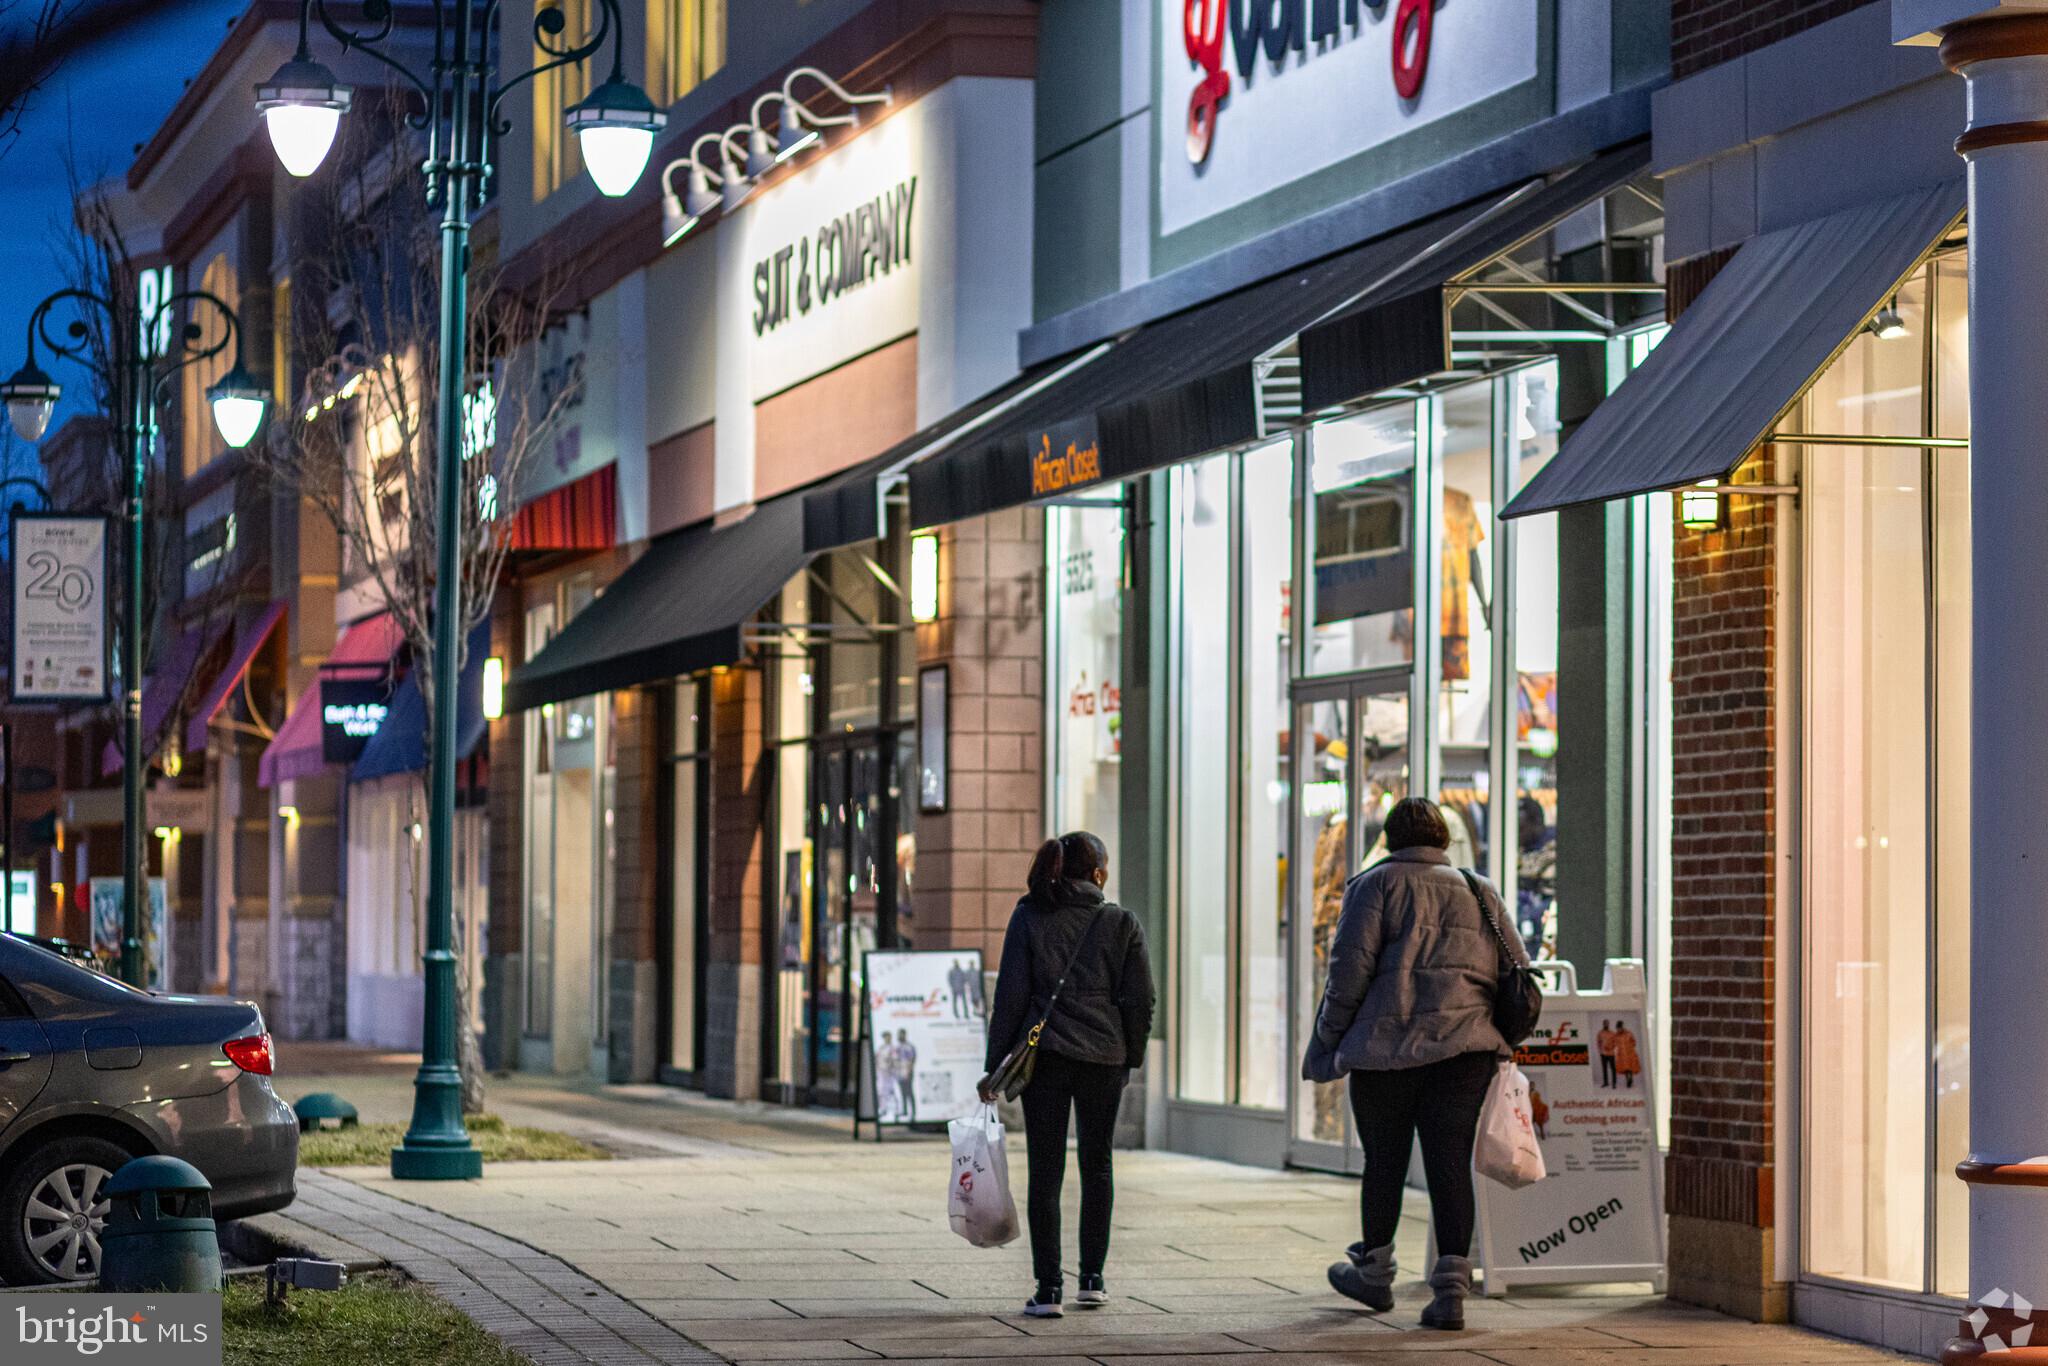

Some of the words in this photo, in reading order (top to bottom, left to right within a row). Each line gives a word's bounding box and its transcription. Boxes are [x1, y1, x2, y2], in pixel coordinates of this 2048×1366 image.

[754, 243, 793, 337] SUIT
[797, 236, 811, 316] &
[816, 175, 918, 305] COMPANY
[1032, 432, 1069, 496] African
[1066, 440, 1101, 485] Closet
[25, 550, 95, 614] 20
[1552, 1098, 1604, 1110] Authentic
[1606, 1097, 1645, 1109] African
[1562, 1114, 1608, 1126] Clothing
[1609, 1114, 1637, 1124] store
[1518, 1228, 1566, 1264] Now
[1568, 1197, 1623, 1232] Open
